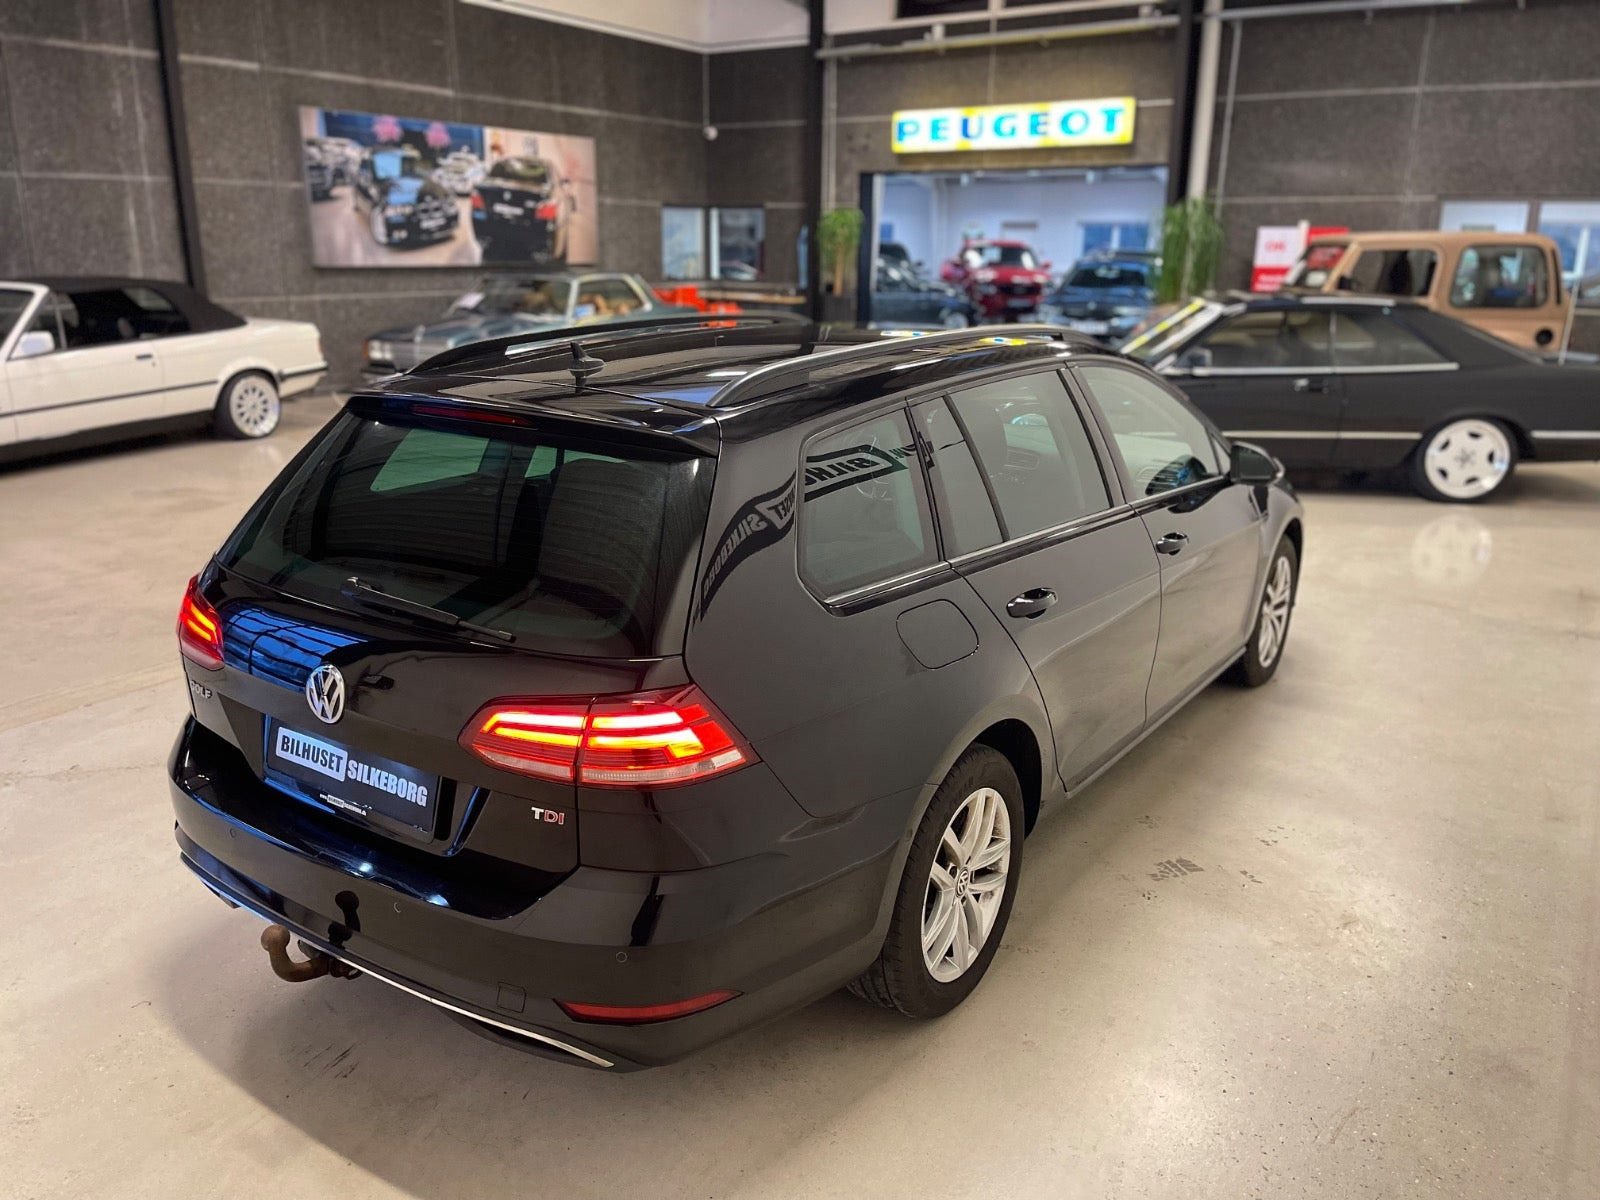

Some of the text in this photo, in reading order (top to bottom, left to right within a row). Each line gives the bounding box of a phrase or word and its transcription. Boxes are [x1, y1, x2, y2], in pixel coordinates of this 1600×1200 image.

[896, 108, 1124, 142] PEUGEOT
[190, 680, 213, 699] GOLF
[281, 735, 343, 773] BILHUSET
[347, 759, 428, 807] SILKEBORG
[531, 806, 565, 825] TDI
